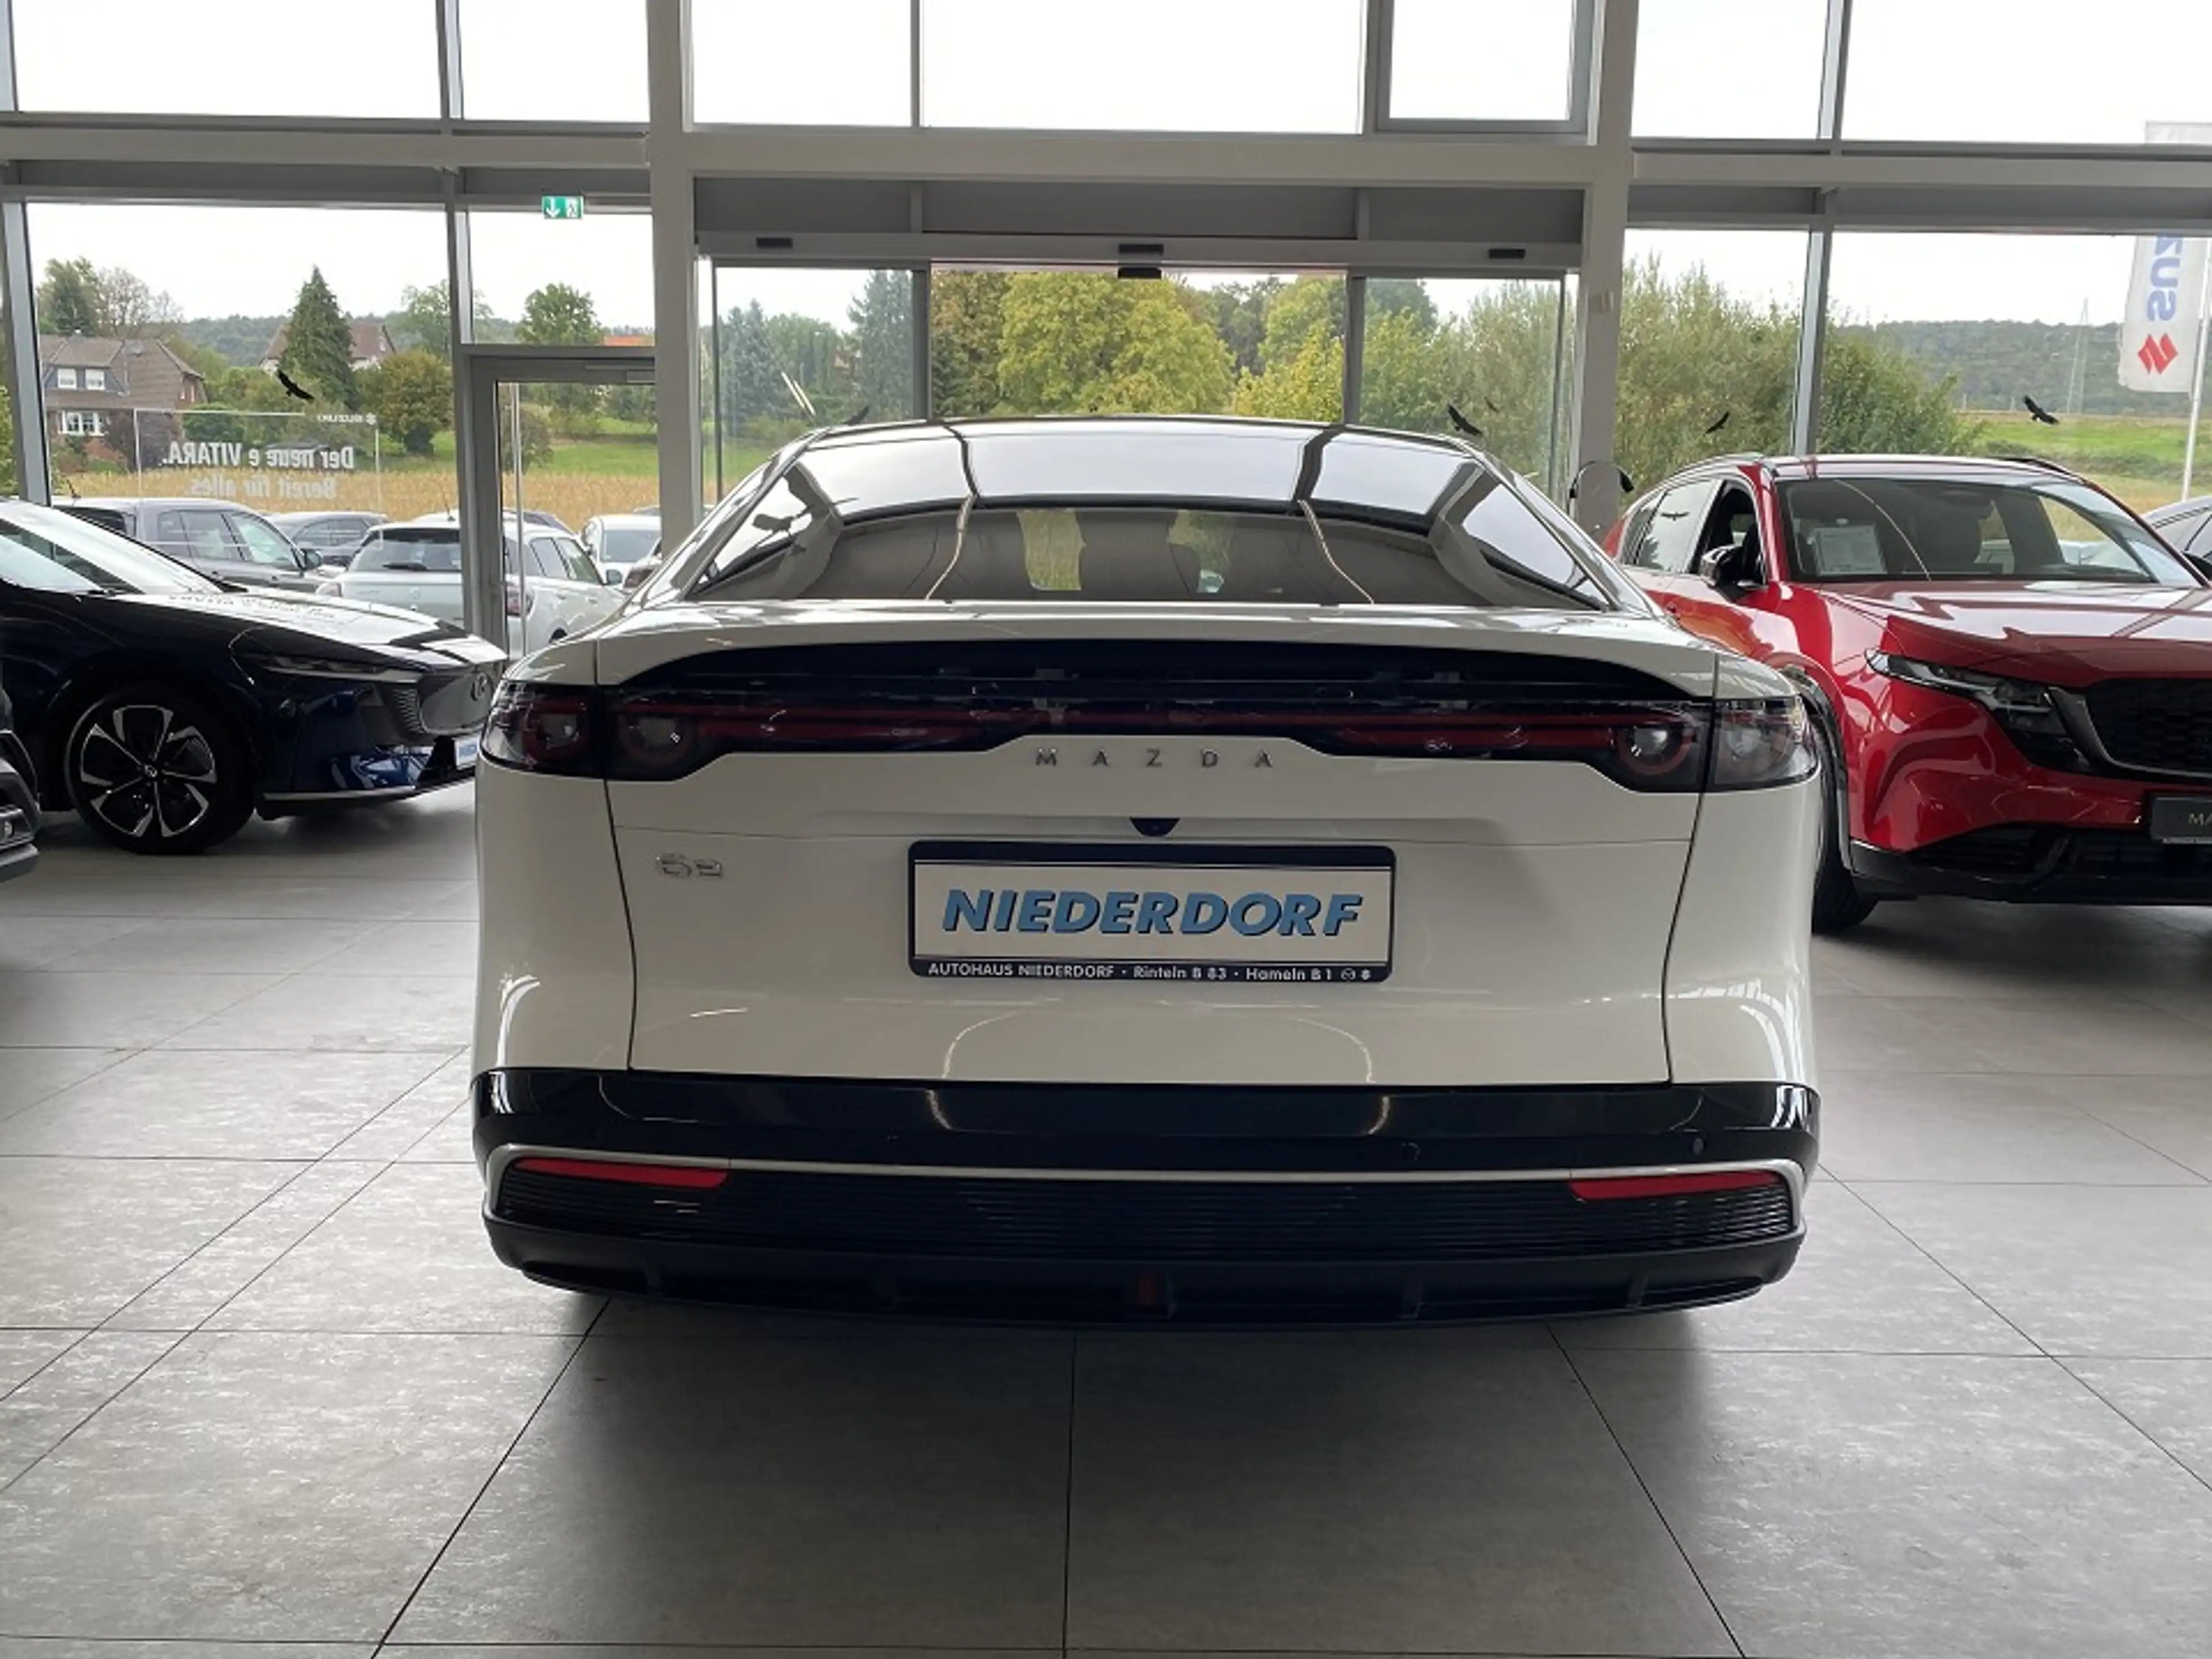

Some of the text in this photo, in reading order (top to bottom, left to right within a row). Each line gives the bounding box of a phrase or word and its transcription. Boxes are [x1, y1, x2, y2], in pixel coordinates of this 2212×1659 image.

[1036, 748, 1272, 768] MAZDA
[942, 889, 1363, 937] NIEDERDORF
[928, 963, 1013, 976] AUTOHAUS
[1018, 964, 1115, 978] NIEDERDORF
[1133, 965, 1187, 979] Rinteln
[1246, 968, 1306, 980] Hameln
[1310, 969, 1321, 980] B
[1326, 969, 1332, 980] 1
